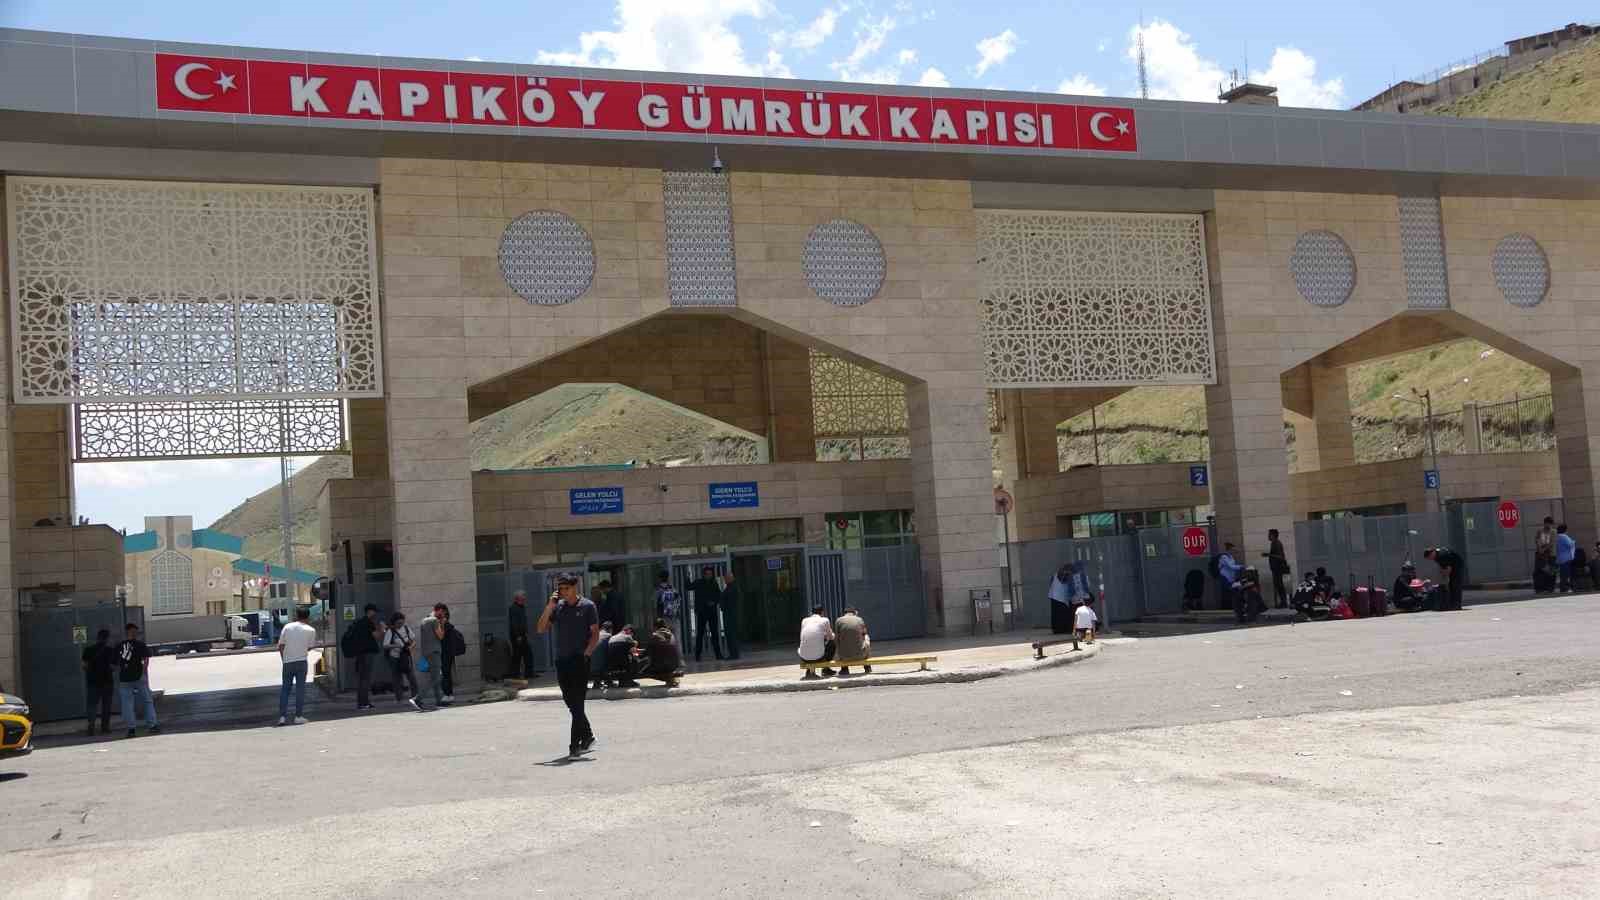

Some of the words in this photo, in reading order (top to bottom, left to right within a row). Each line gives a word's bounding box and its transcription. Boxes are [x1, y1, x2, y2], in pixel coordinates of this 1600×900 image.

[289, 75, 606, 127] KAPIKÖY
[636, 83, 870, 136] GÜMRÜK
[889, 107, 1055, 146] KAPISI
[1194, 472, 1204, 485] 2
[1428, 476, 1437, 488] 3
[1498, 509, 1519, 521] DUR
[1183, 535, 1206, 548] DUR
